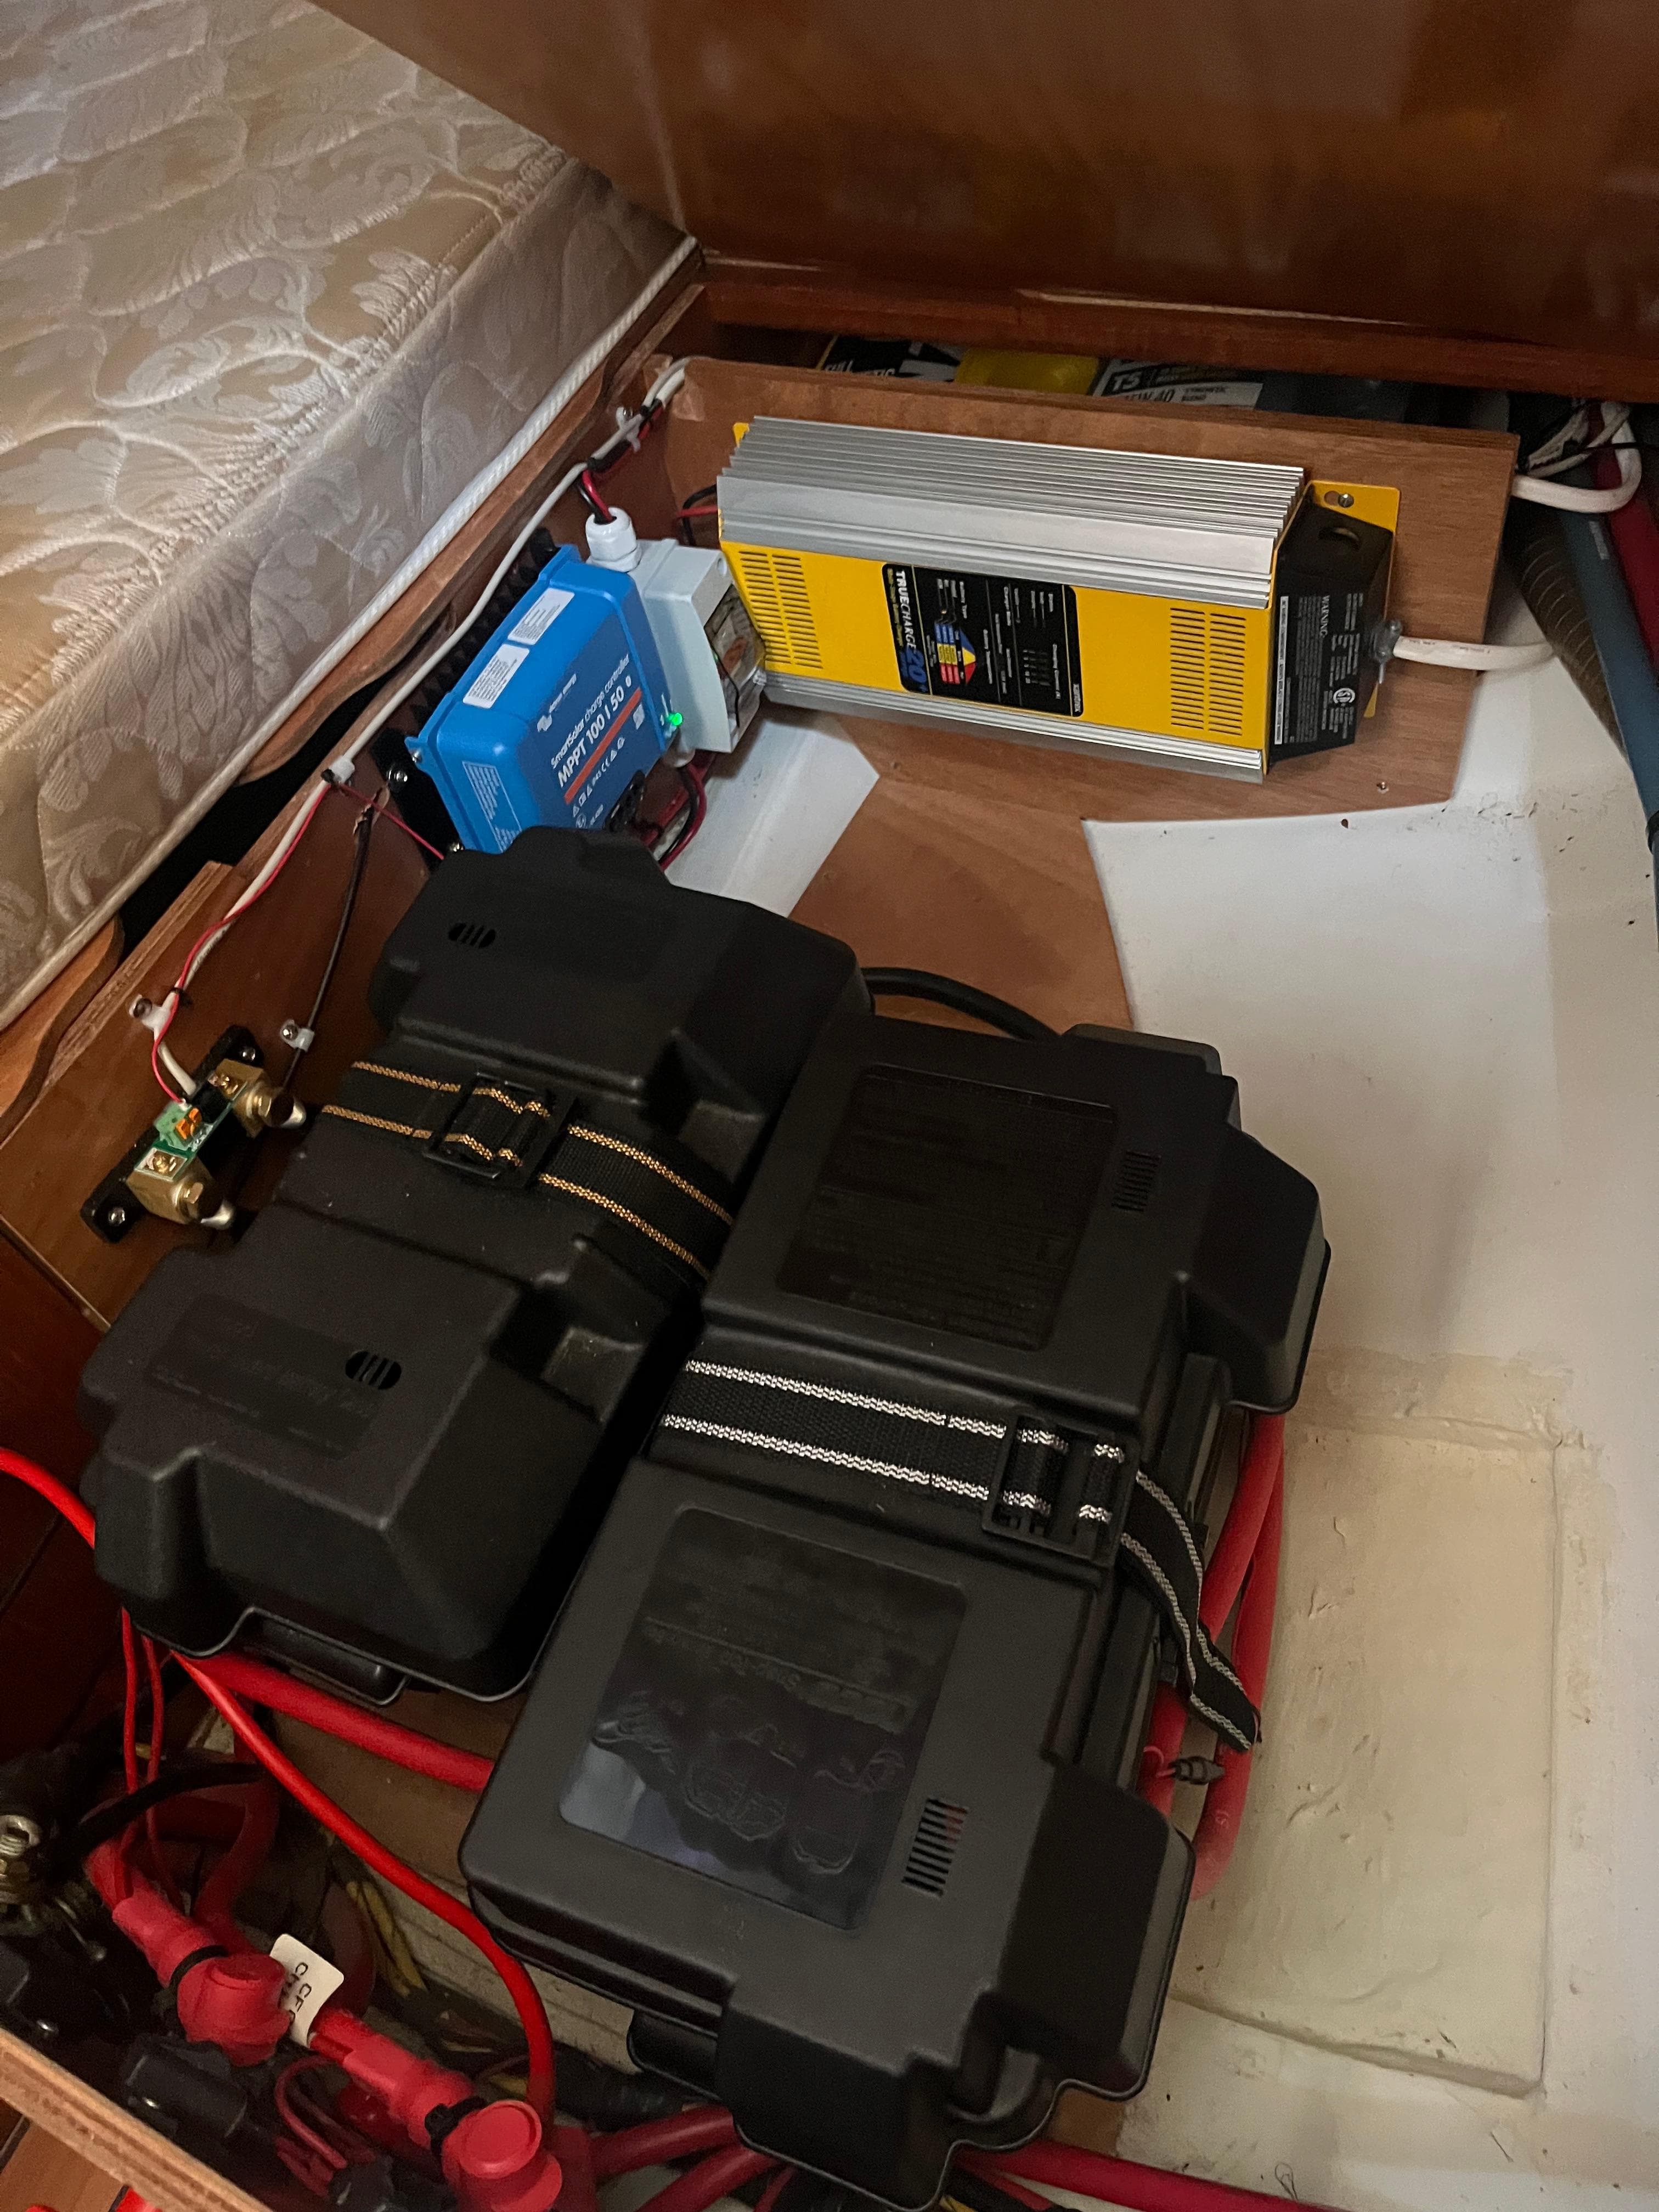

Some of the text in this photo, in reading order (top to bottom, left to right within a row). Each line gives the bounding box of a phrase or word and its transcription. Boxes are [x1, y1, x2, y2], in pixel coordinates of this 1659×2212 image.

[551, 718, 584, 769] SmartSolar
[584, 690, 605, 723] charge
[605, 653, 629, 693] controller
[558, 737, 587, 788] MPPT
[585, 713, 606, 744] 100
[610, 685, 625, 712] 50
